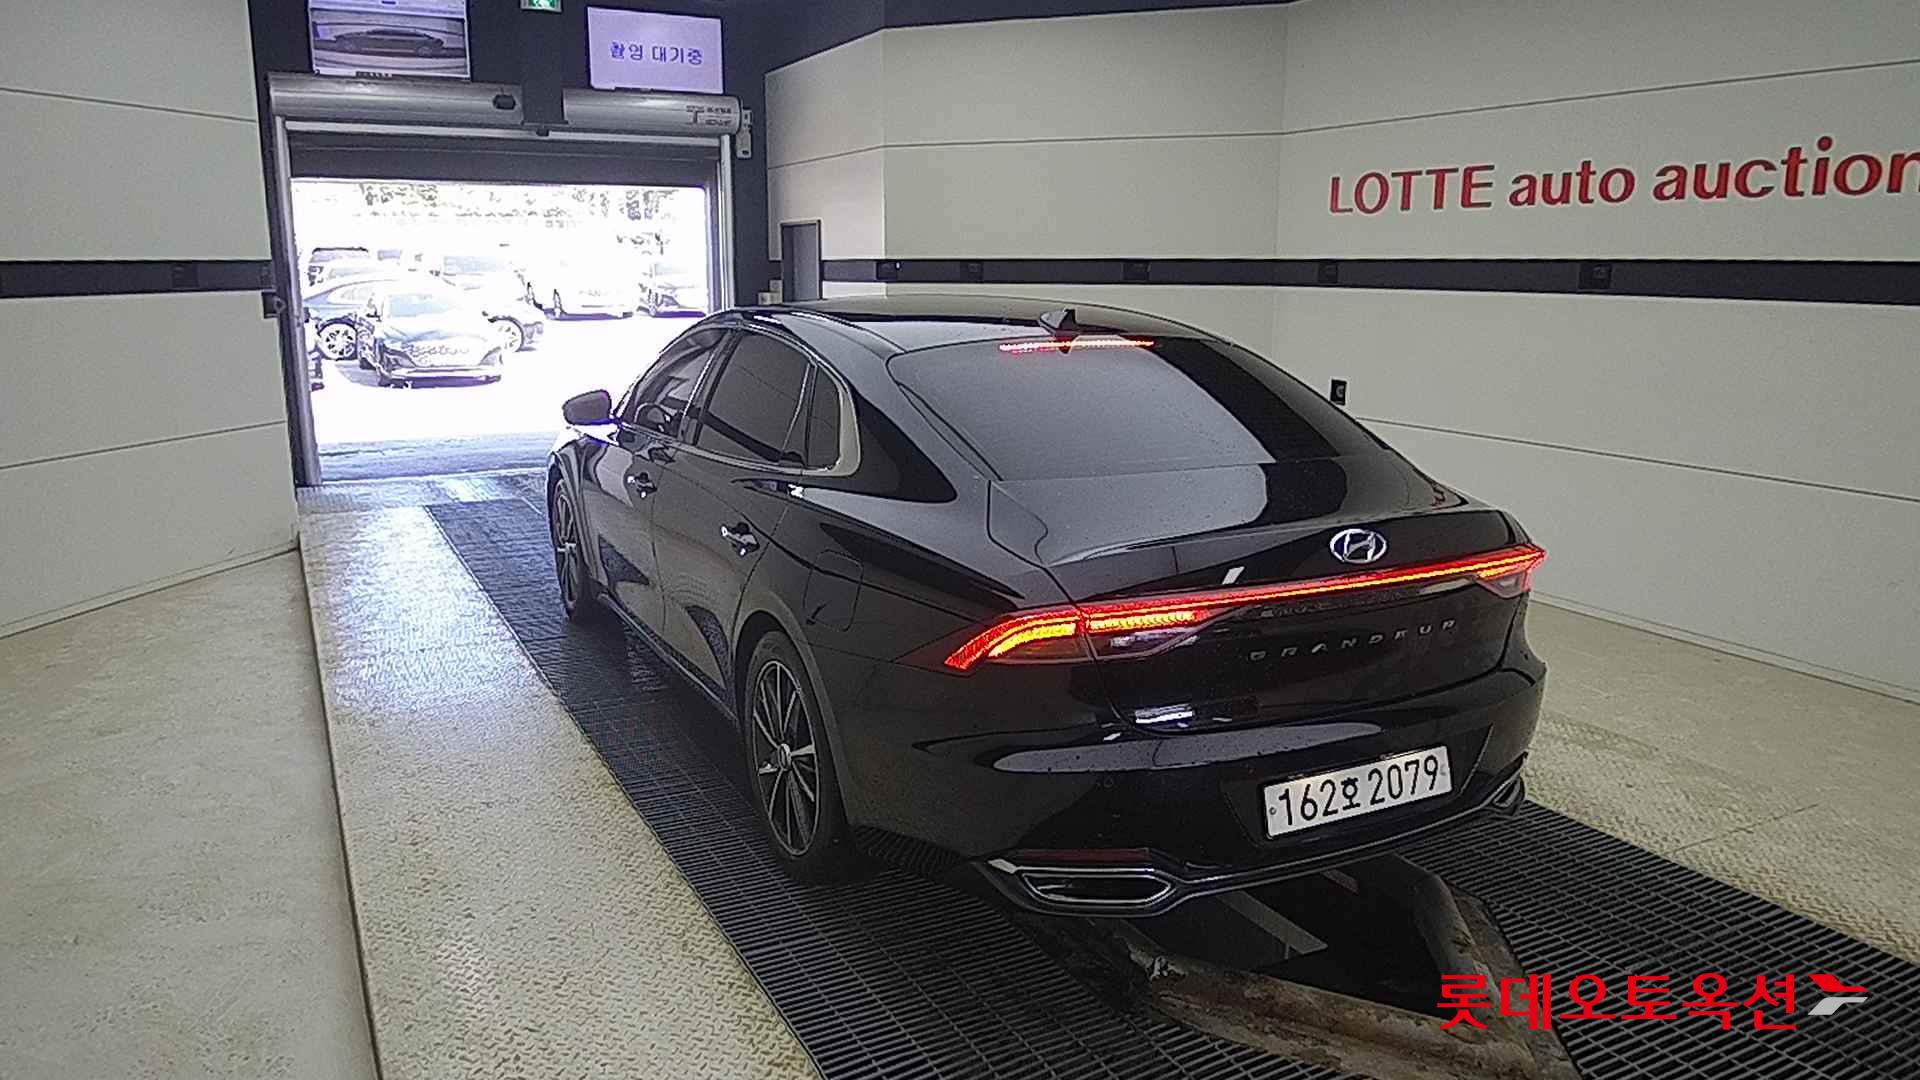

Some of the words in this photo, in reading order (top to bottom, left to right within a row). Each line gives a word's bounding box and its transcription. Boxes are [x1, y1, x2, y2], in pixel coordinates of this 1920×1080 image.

[652, 46, 703, 65] 대기중
[1329, 164, 1496, 214] LOTTE
[1508, 160, 1636, 207] auto
[1278, 777, 1361, 826] 162호
[1367, 755, 1439, 806] 2079
